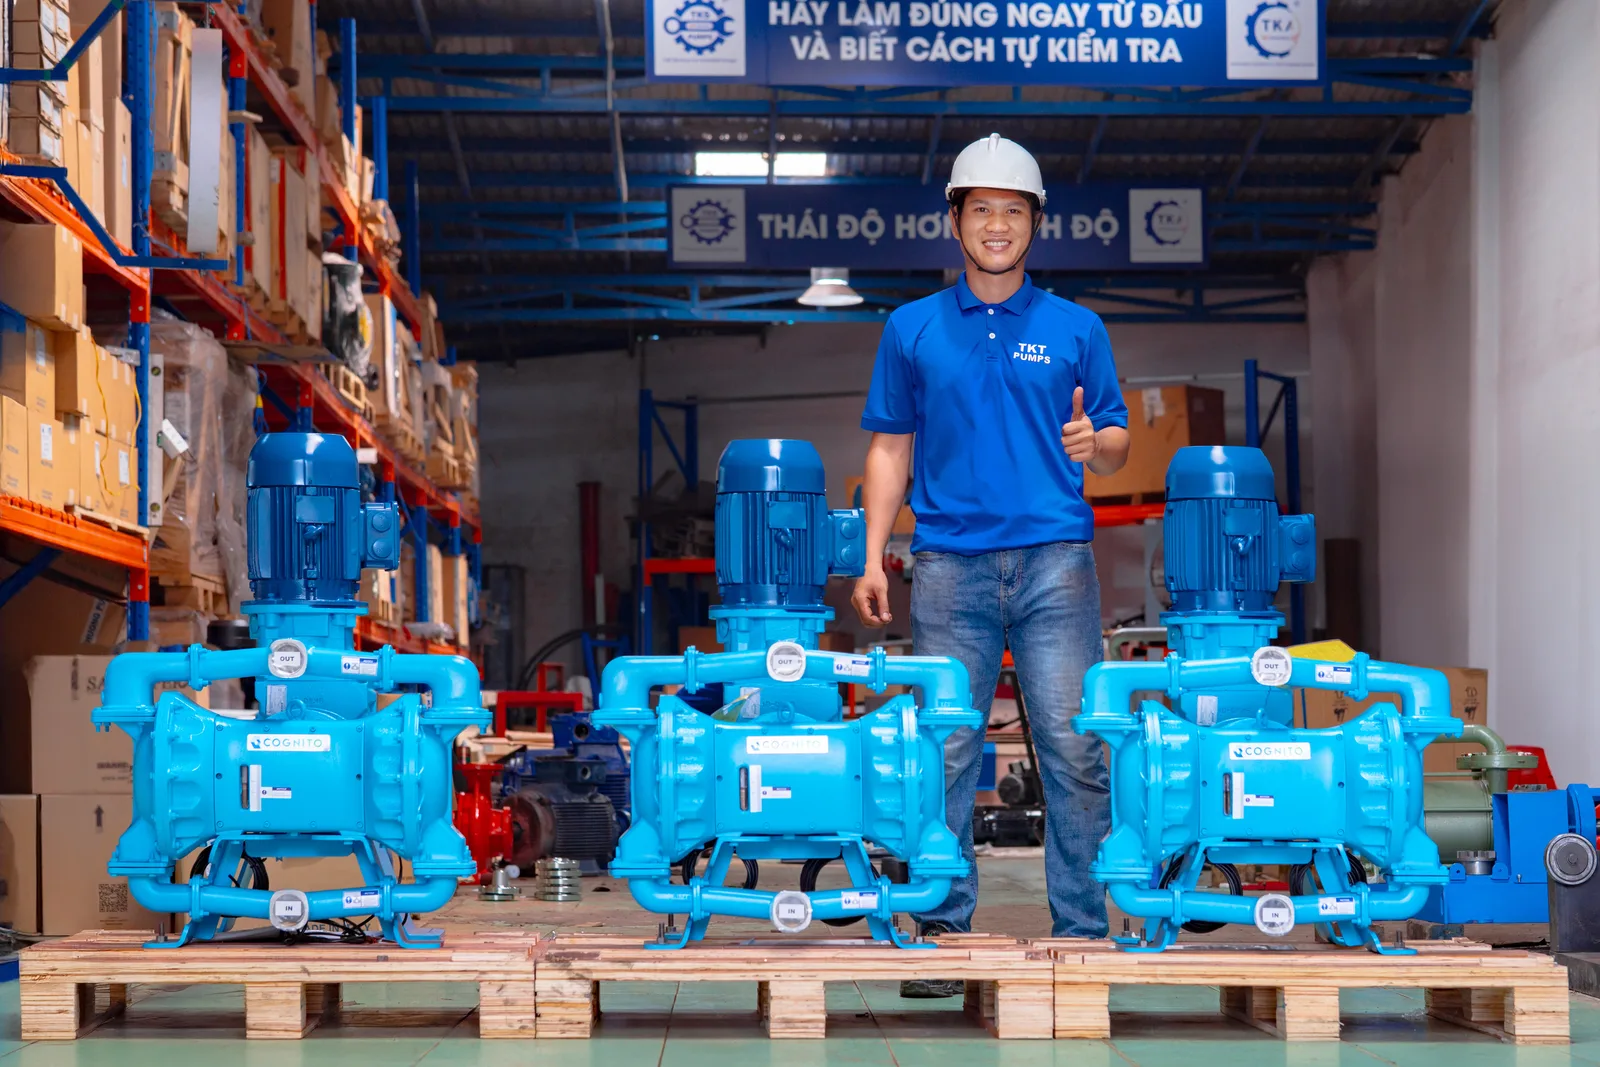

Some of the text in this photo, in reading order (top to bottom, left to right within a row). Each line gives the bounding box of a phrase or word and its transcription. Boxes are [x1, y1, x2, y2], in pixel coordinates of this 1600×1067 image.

[1006, 2, 1091, 28] NGAY
[789, 28, 1183, 69] VÀ BIẾT CÁCH TỰ KIỂM TRA
[757, 208, 829, 240] THÁI
[836, 208, 886, 246] ĐỘ
[1070, 208, 1120, 246] ĐỘ
[1018, 342, 1047, 354] TKT
[1013, 352, 1051, 365] PUMPS
[263, 737, 323, 748] COGNITO
[762, 740, 821, 749] COGNITO
[1245, 746, 1304, 756] COGNITO
